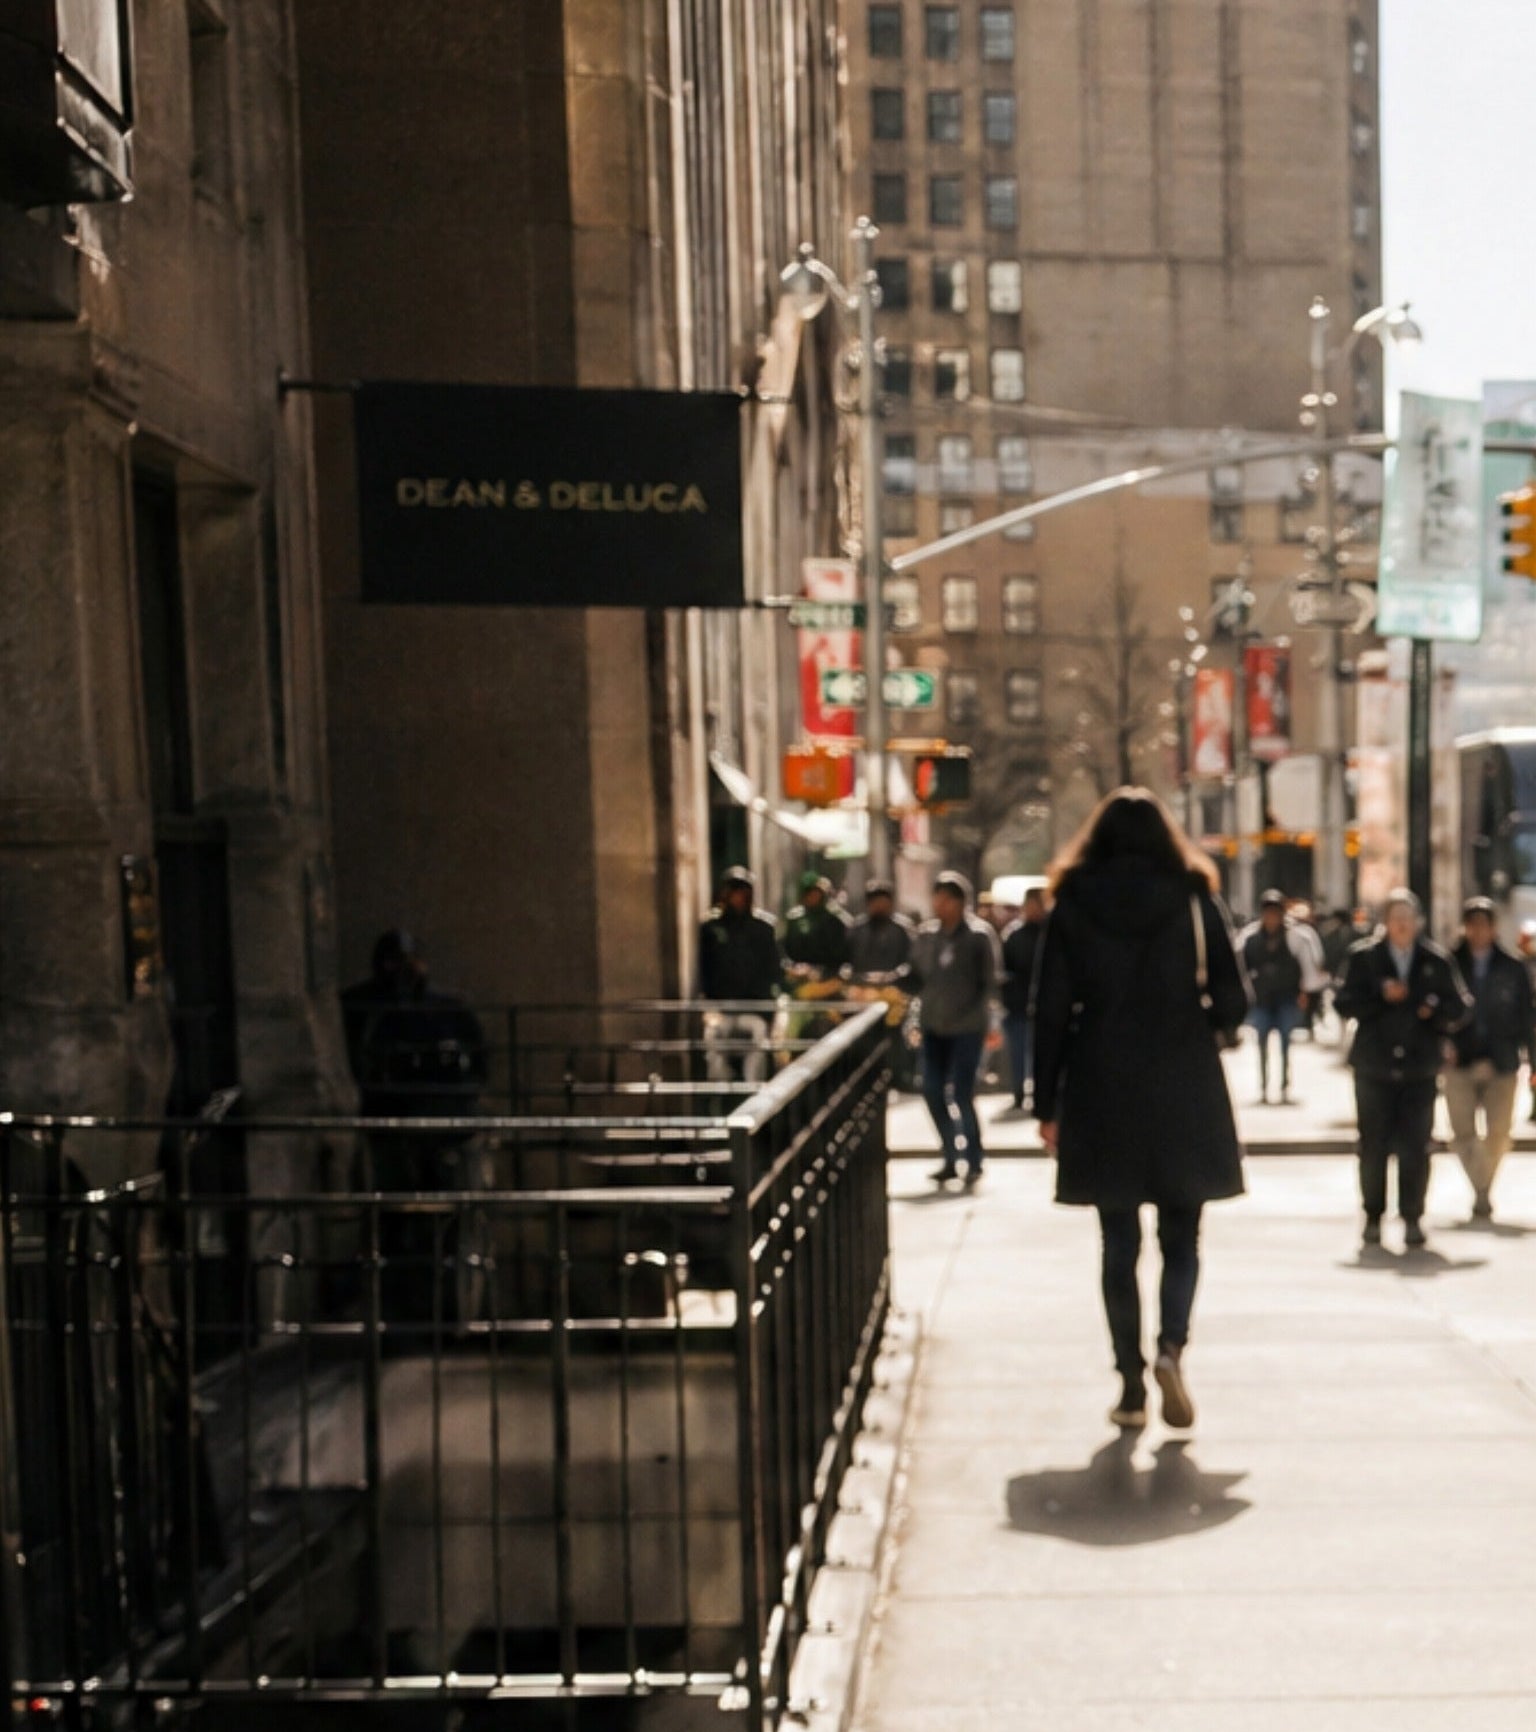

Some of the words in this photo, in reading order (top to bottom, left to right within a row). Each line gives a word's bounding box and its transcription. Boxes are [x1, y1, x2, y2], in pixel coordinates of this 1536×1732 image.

[397, 478, 506, 508] DEAN
[514, 480, 541, 510] &
[550, 482, 707, 514] DELUCA
